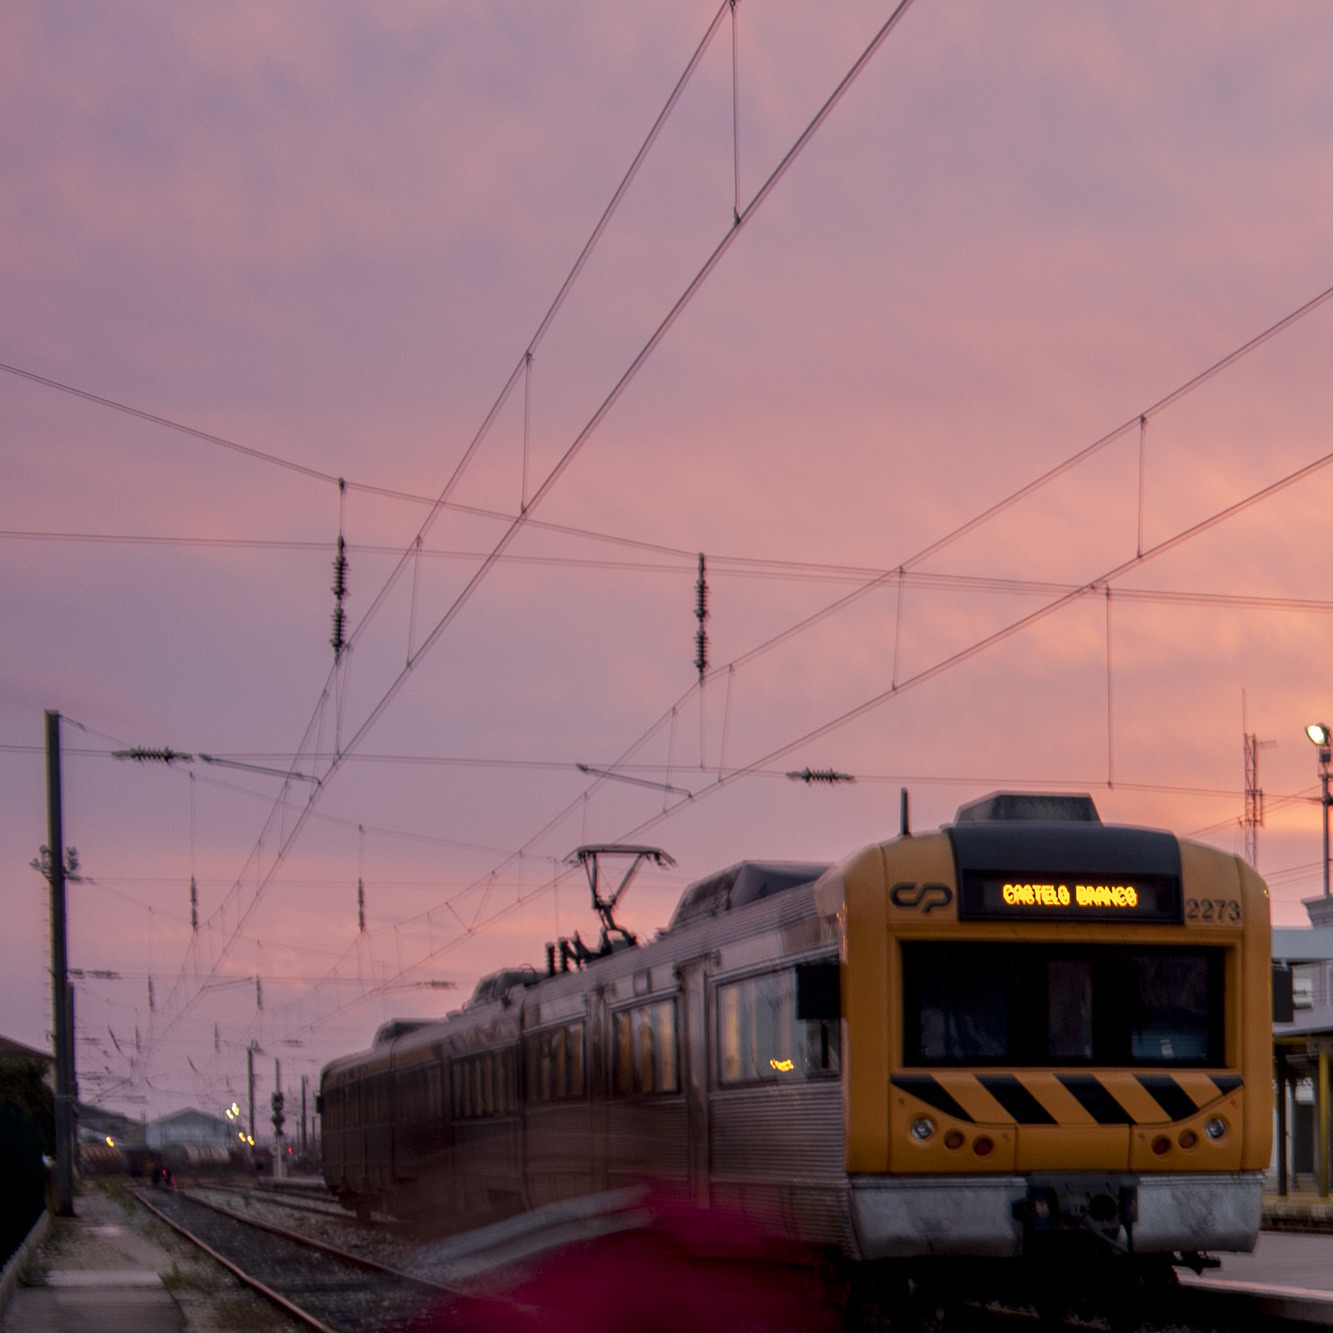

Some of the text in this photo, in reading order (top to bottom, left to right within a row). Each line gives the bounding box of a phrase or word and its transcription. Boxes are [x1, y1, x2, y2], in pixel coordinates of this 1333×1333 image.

[1002, 884, 1138, 907] CASTELO BRANCO
[1186, 899, 1241, 921] 2273
